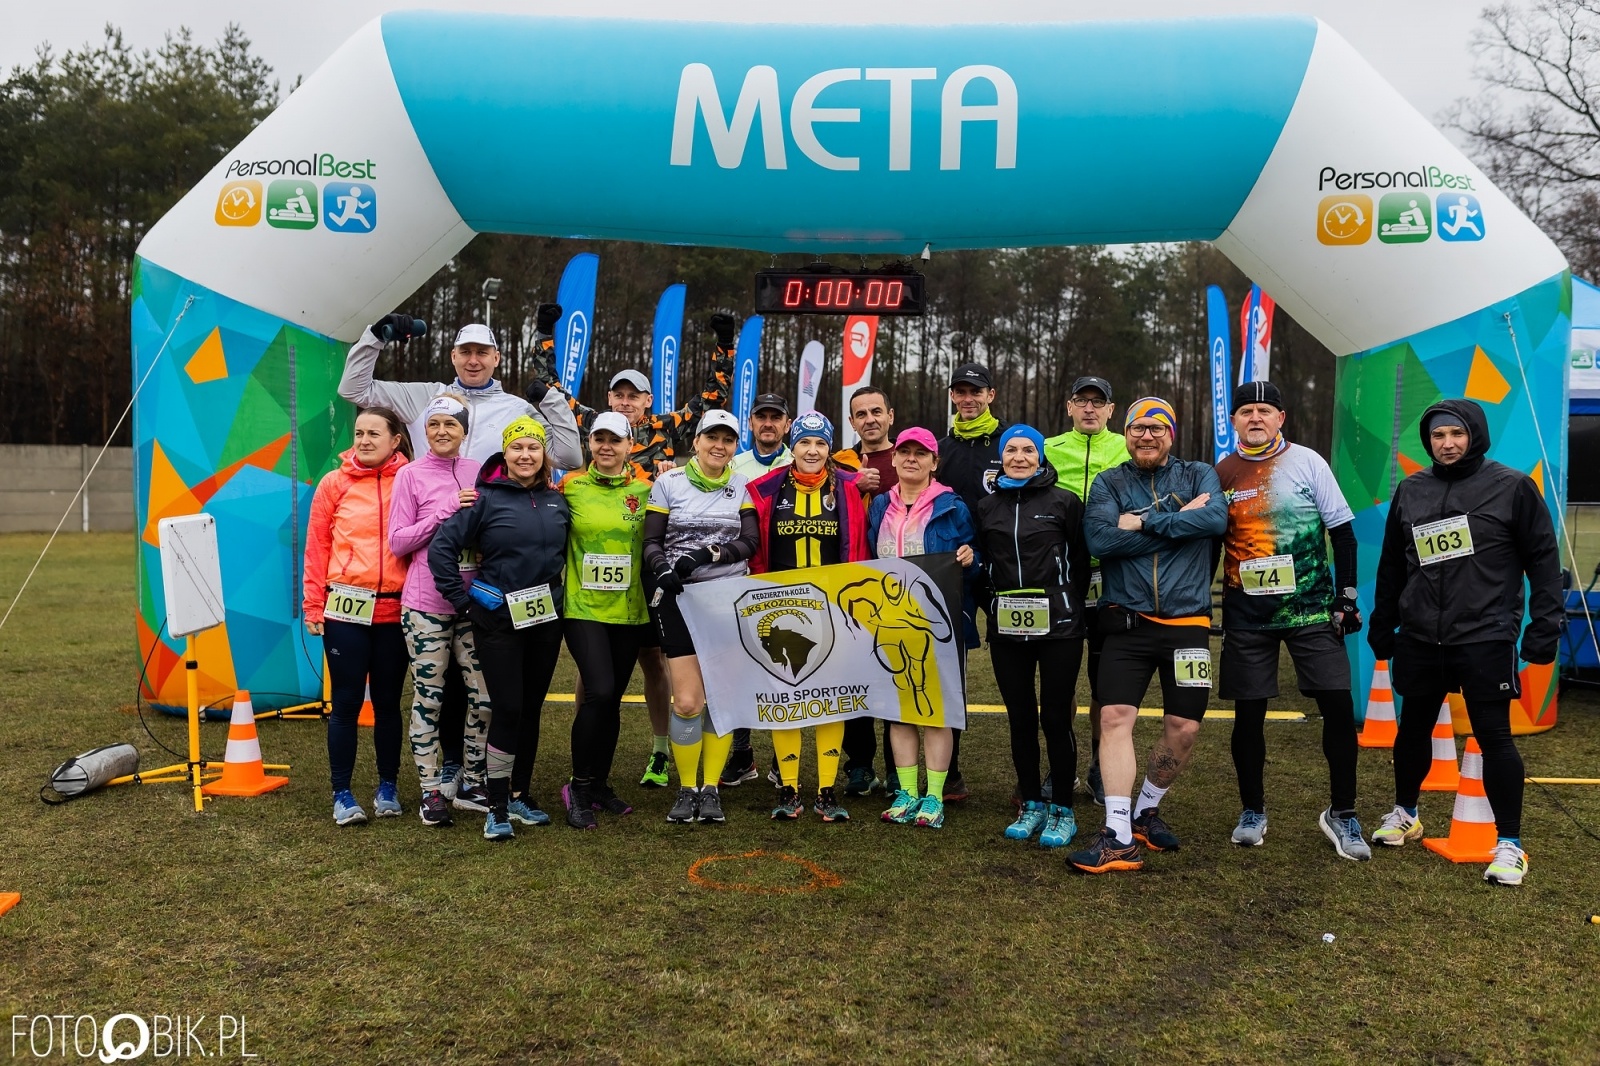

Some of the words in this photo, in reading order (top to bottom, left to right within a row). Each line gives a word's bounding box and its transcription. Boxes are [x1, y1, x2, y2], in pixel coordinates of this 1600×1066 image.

[670, 62, 1019, 171] META
[225, 153, 377, 180] PersonalBest
[1318, 165, 1477, 192] PersonalBest
[784, 280, 903, 307] 0:00:00
[564, 321, 583, 396] FAMET
[777, 525, 838, 536] KOZIOŁEK
[797, 519, 838, 527] SPORTOWY
[1425, 531, 1463, 555] 163
[592, 566, 623, 583] 155
[1255, 569, 1281, 587] 74
[752, 587, 811, 601] KĘDZIERZYN-KOŹLE
[335, 595, 367, 616] 107
[525, 598, 546, 618] 55
[748, 602, 762, 613] KS
[764, 599, 816, 610] KOZIOŁEK
[1011, 610, 1035, 628] 98
[755, 692, 790, 704] KLUB
[793, 684, 870, 701] SPORTOWY
[757, 694, 870, 723] KOZIOŁEK
